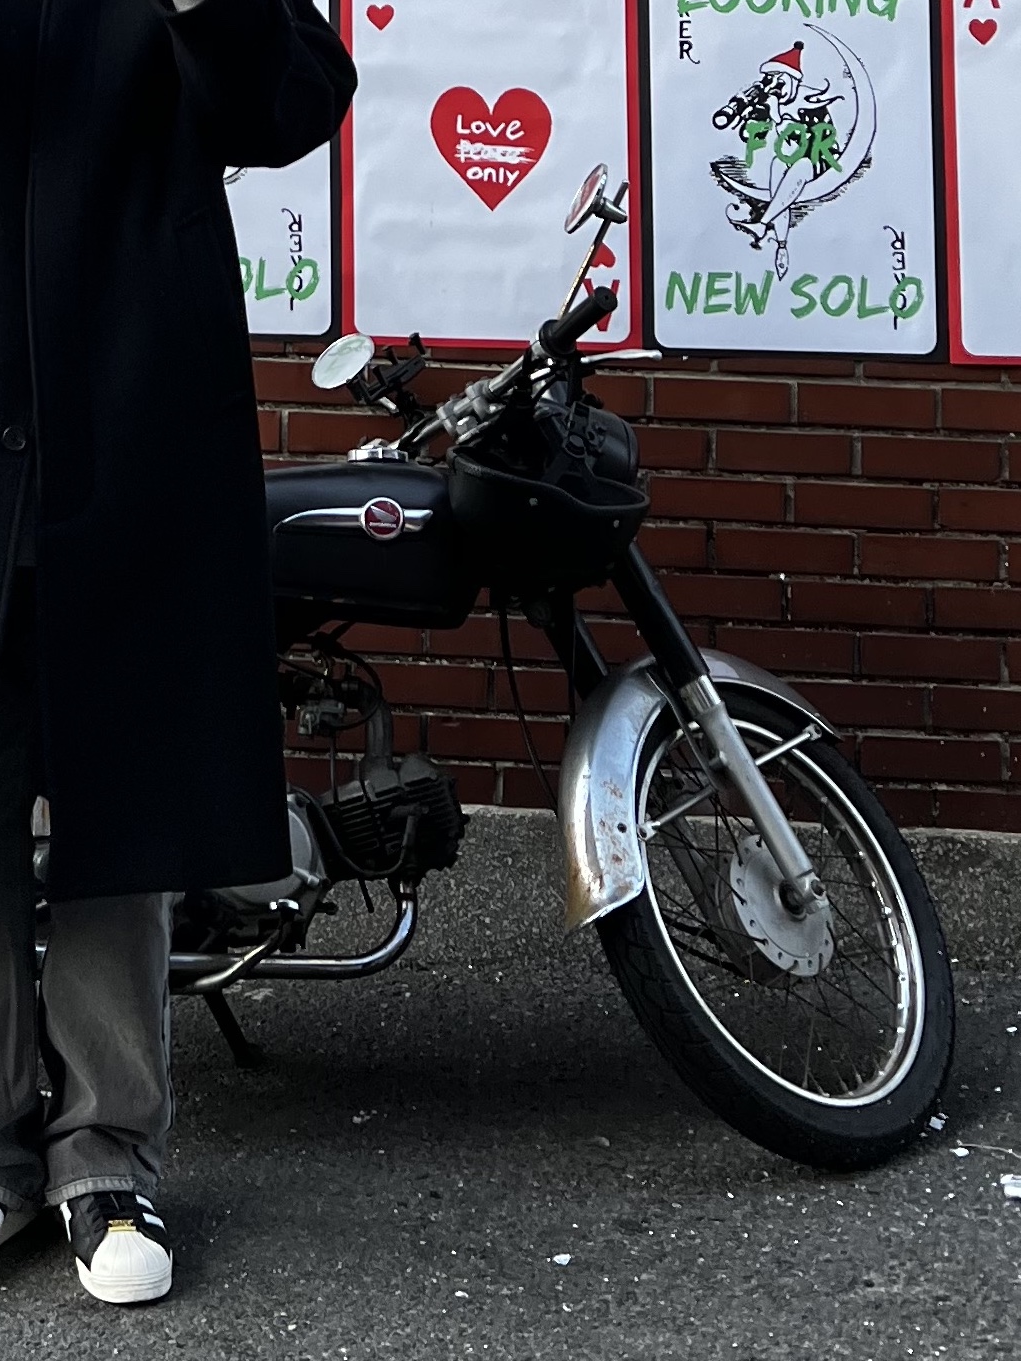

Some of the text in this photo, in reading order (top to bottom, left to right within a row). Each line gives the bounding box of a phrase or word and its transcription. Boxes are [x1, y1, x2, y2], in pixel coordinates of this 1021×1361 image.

[455, 113, 525, 141] Love
[744, 120, 844, 174] FOR
[466, 166, 521, 187] only
[664, 269, 775, 316] NEW
[790, 273, 925, 320] SOLO
